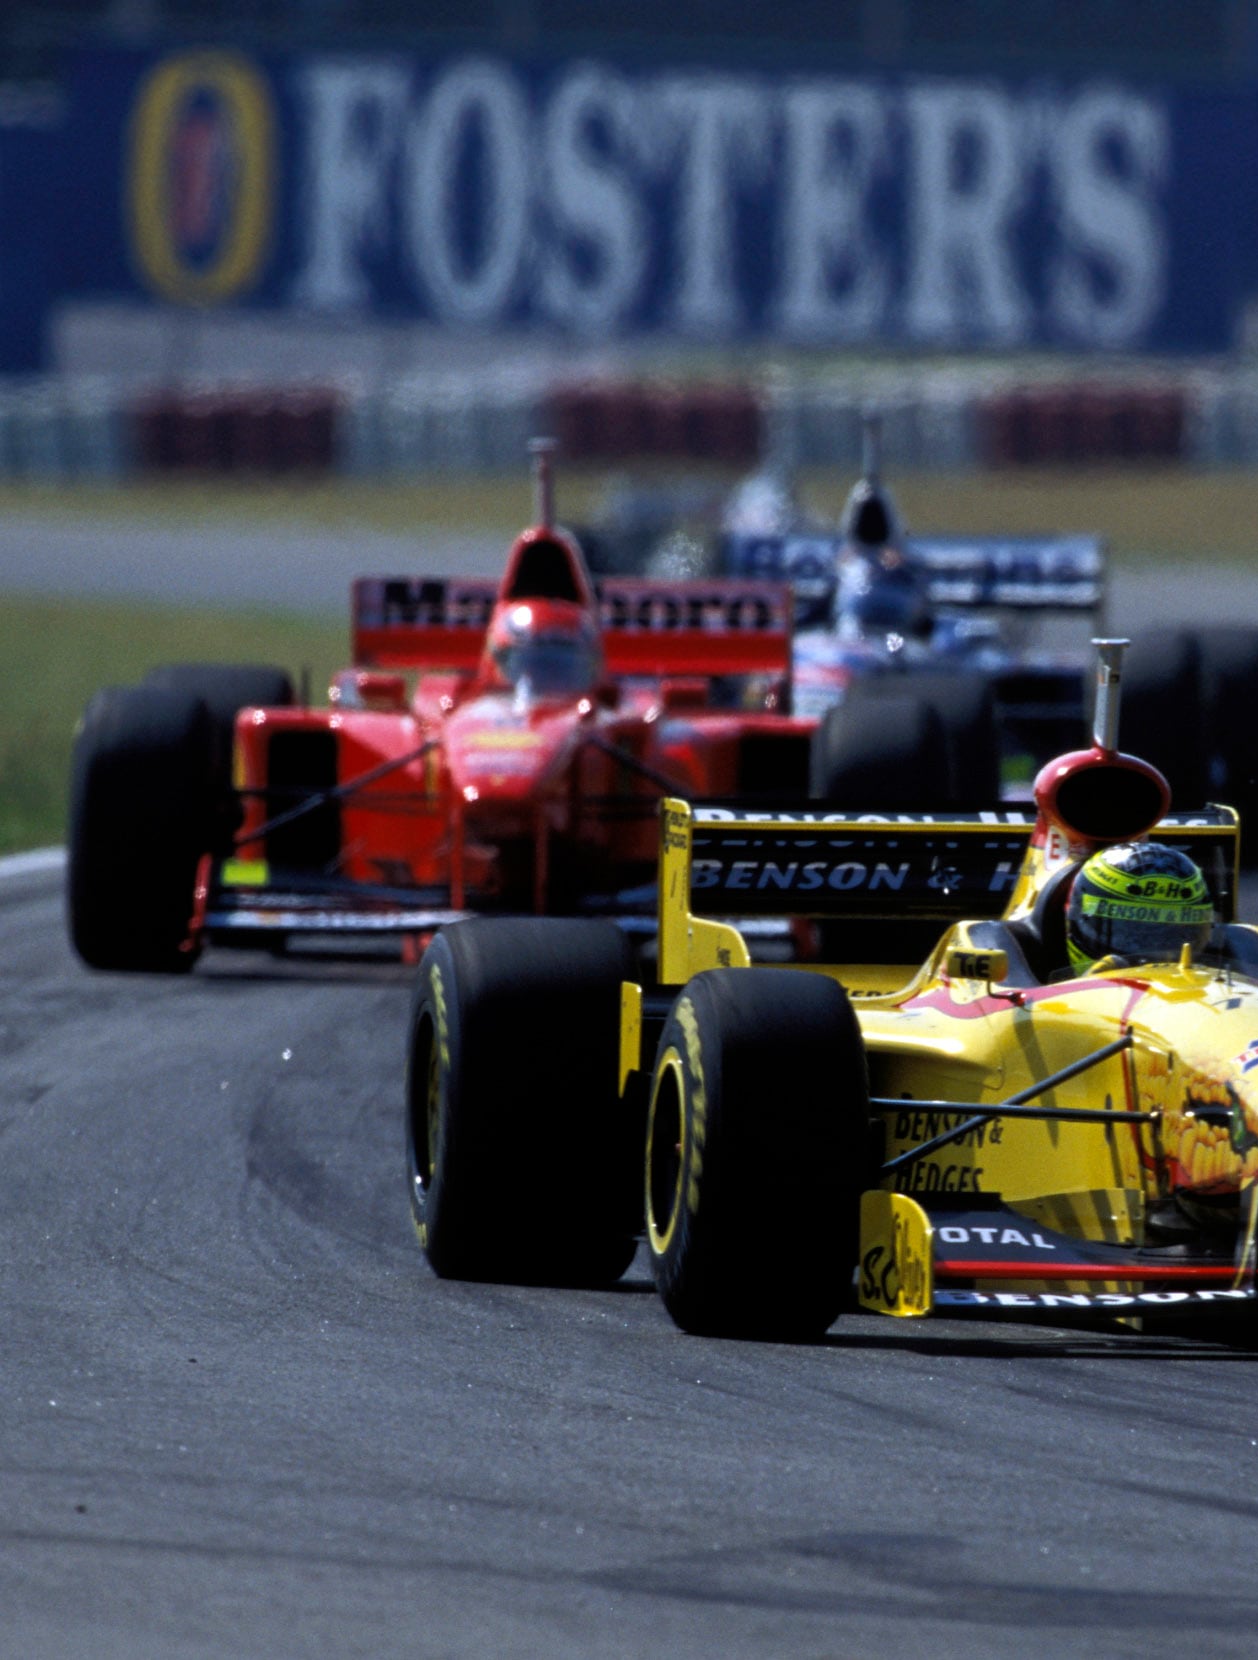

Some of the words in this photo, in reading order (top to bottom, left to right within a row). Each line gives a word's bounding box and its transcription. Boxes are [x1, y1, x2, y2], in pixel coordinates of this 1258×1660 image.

[691, 859, 910, 890] BENSON
[1097, 900, 1160, 921] BENSON
[932, 1226, 1055, 1250] OTAL
